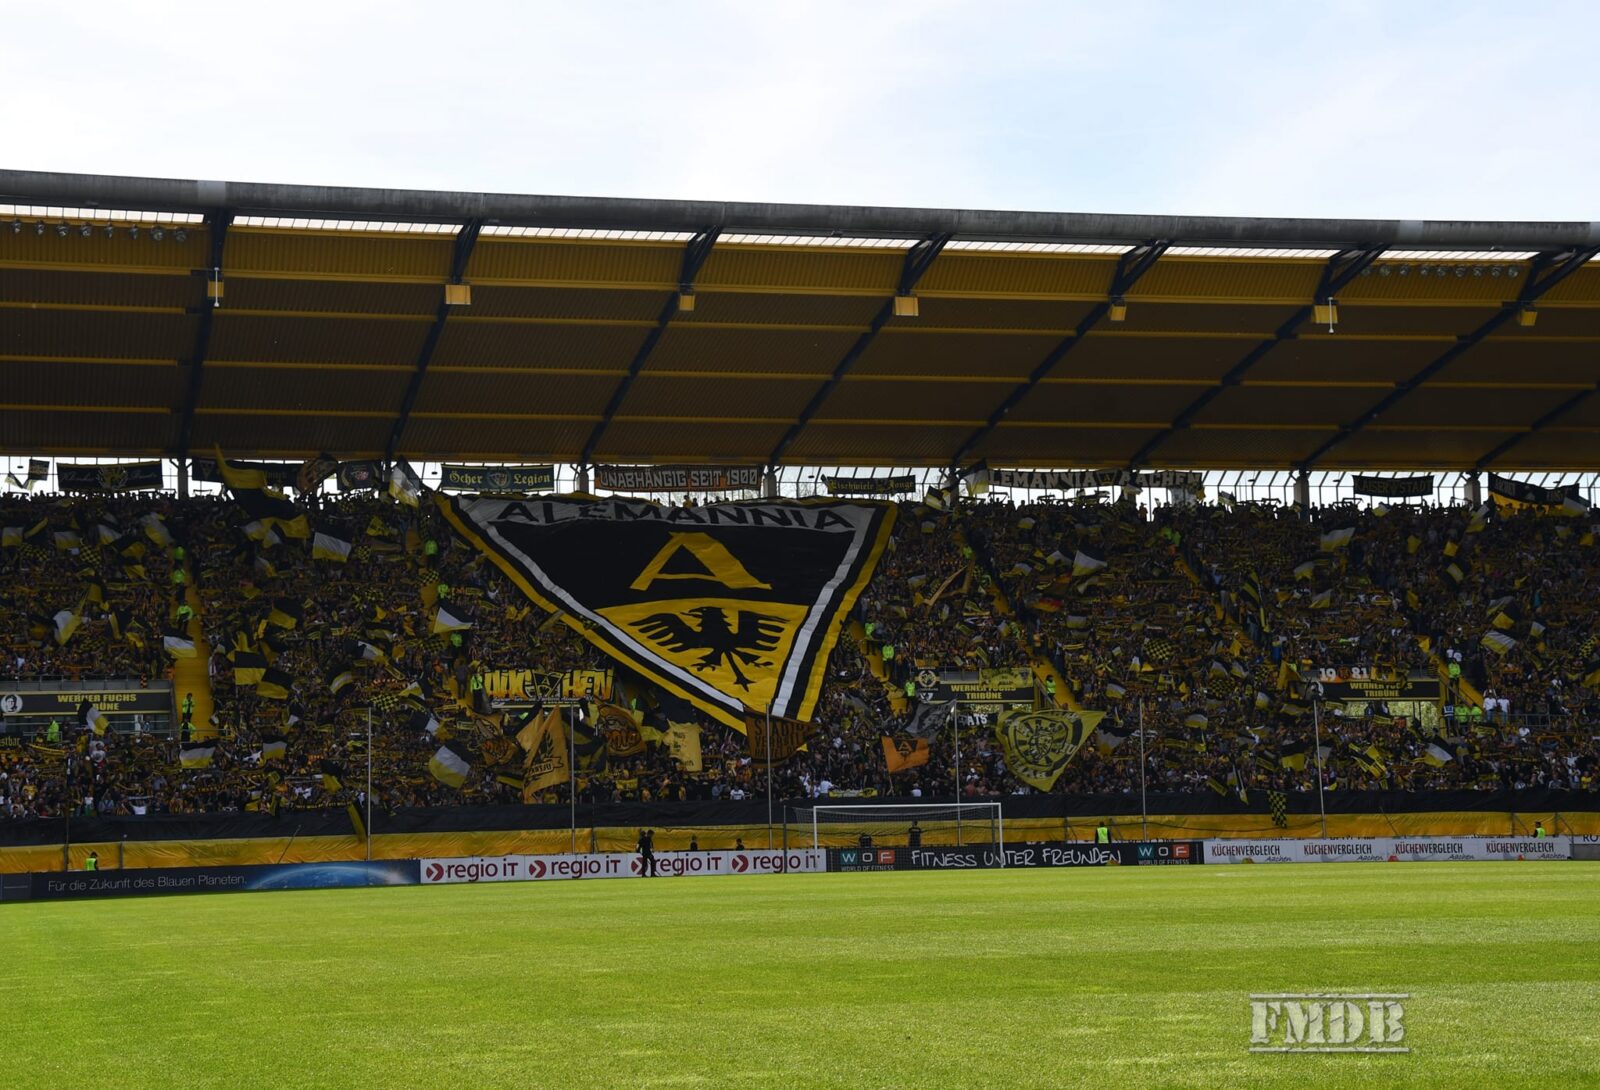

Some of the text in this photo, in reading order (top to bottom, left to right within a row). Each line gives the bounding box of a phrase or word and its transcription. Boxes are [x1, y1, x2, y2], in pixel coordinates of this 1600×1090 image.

[448, 471, 551, 486] Öcher Legion
[599, 468, 758, 488] UNABHÄNGIG SEIT 1900
[988, 471, 1096, 488] LEMANNIA
[497, 499, 856, 530] ALEMANNIA
[75, 702, 120, 711] TBÜNE
[104, 694, 137, 702] FUCHS
[1211, 844, 1281, 857] KÜCHENVERGLEICH
[1303, 842, 1373, 856] KÜCHENVERGLEICH
[1395, 841, 1463, 854] KÜCHENVERGLEICH
[1486, 840, 1555, 853] KÜCHENVERGLEICH
[655, 853, 703, 877] regio
[753, 855, 801, 873] rego
[911, 847, 1122, 868] FITNESS UNTER FREUNDEN
[447, 861, 498, 882] regio
[551, 859, 601, 880] regio
[48, 874, 248, 892] Für die Zukunft des Blauen Planeten.
